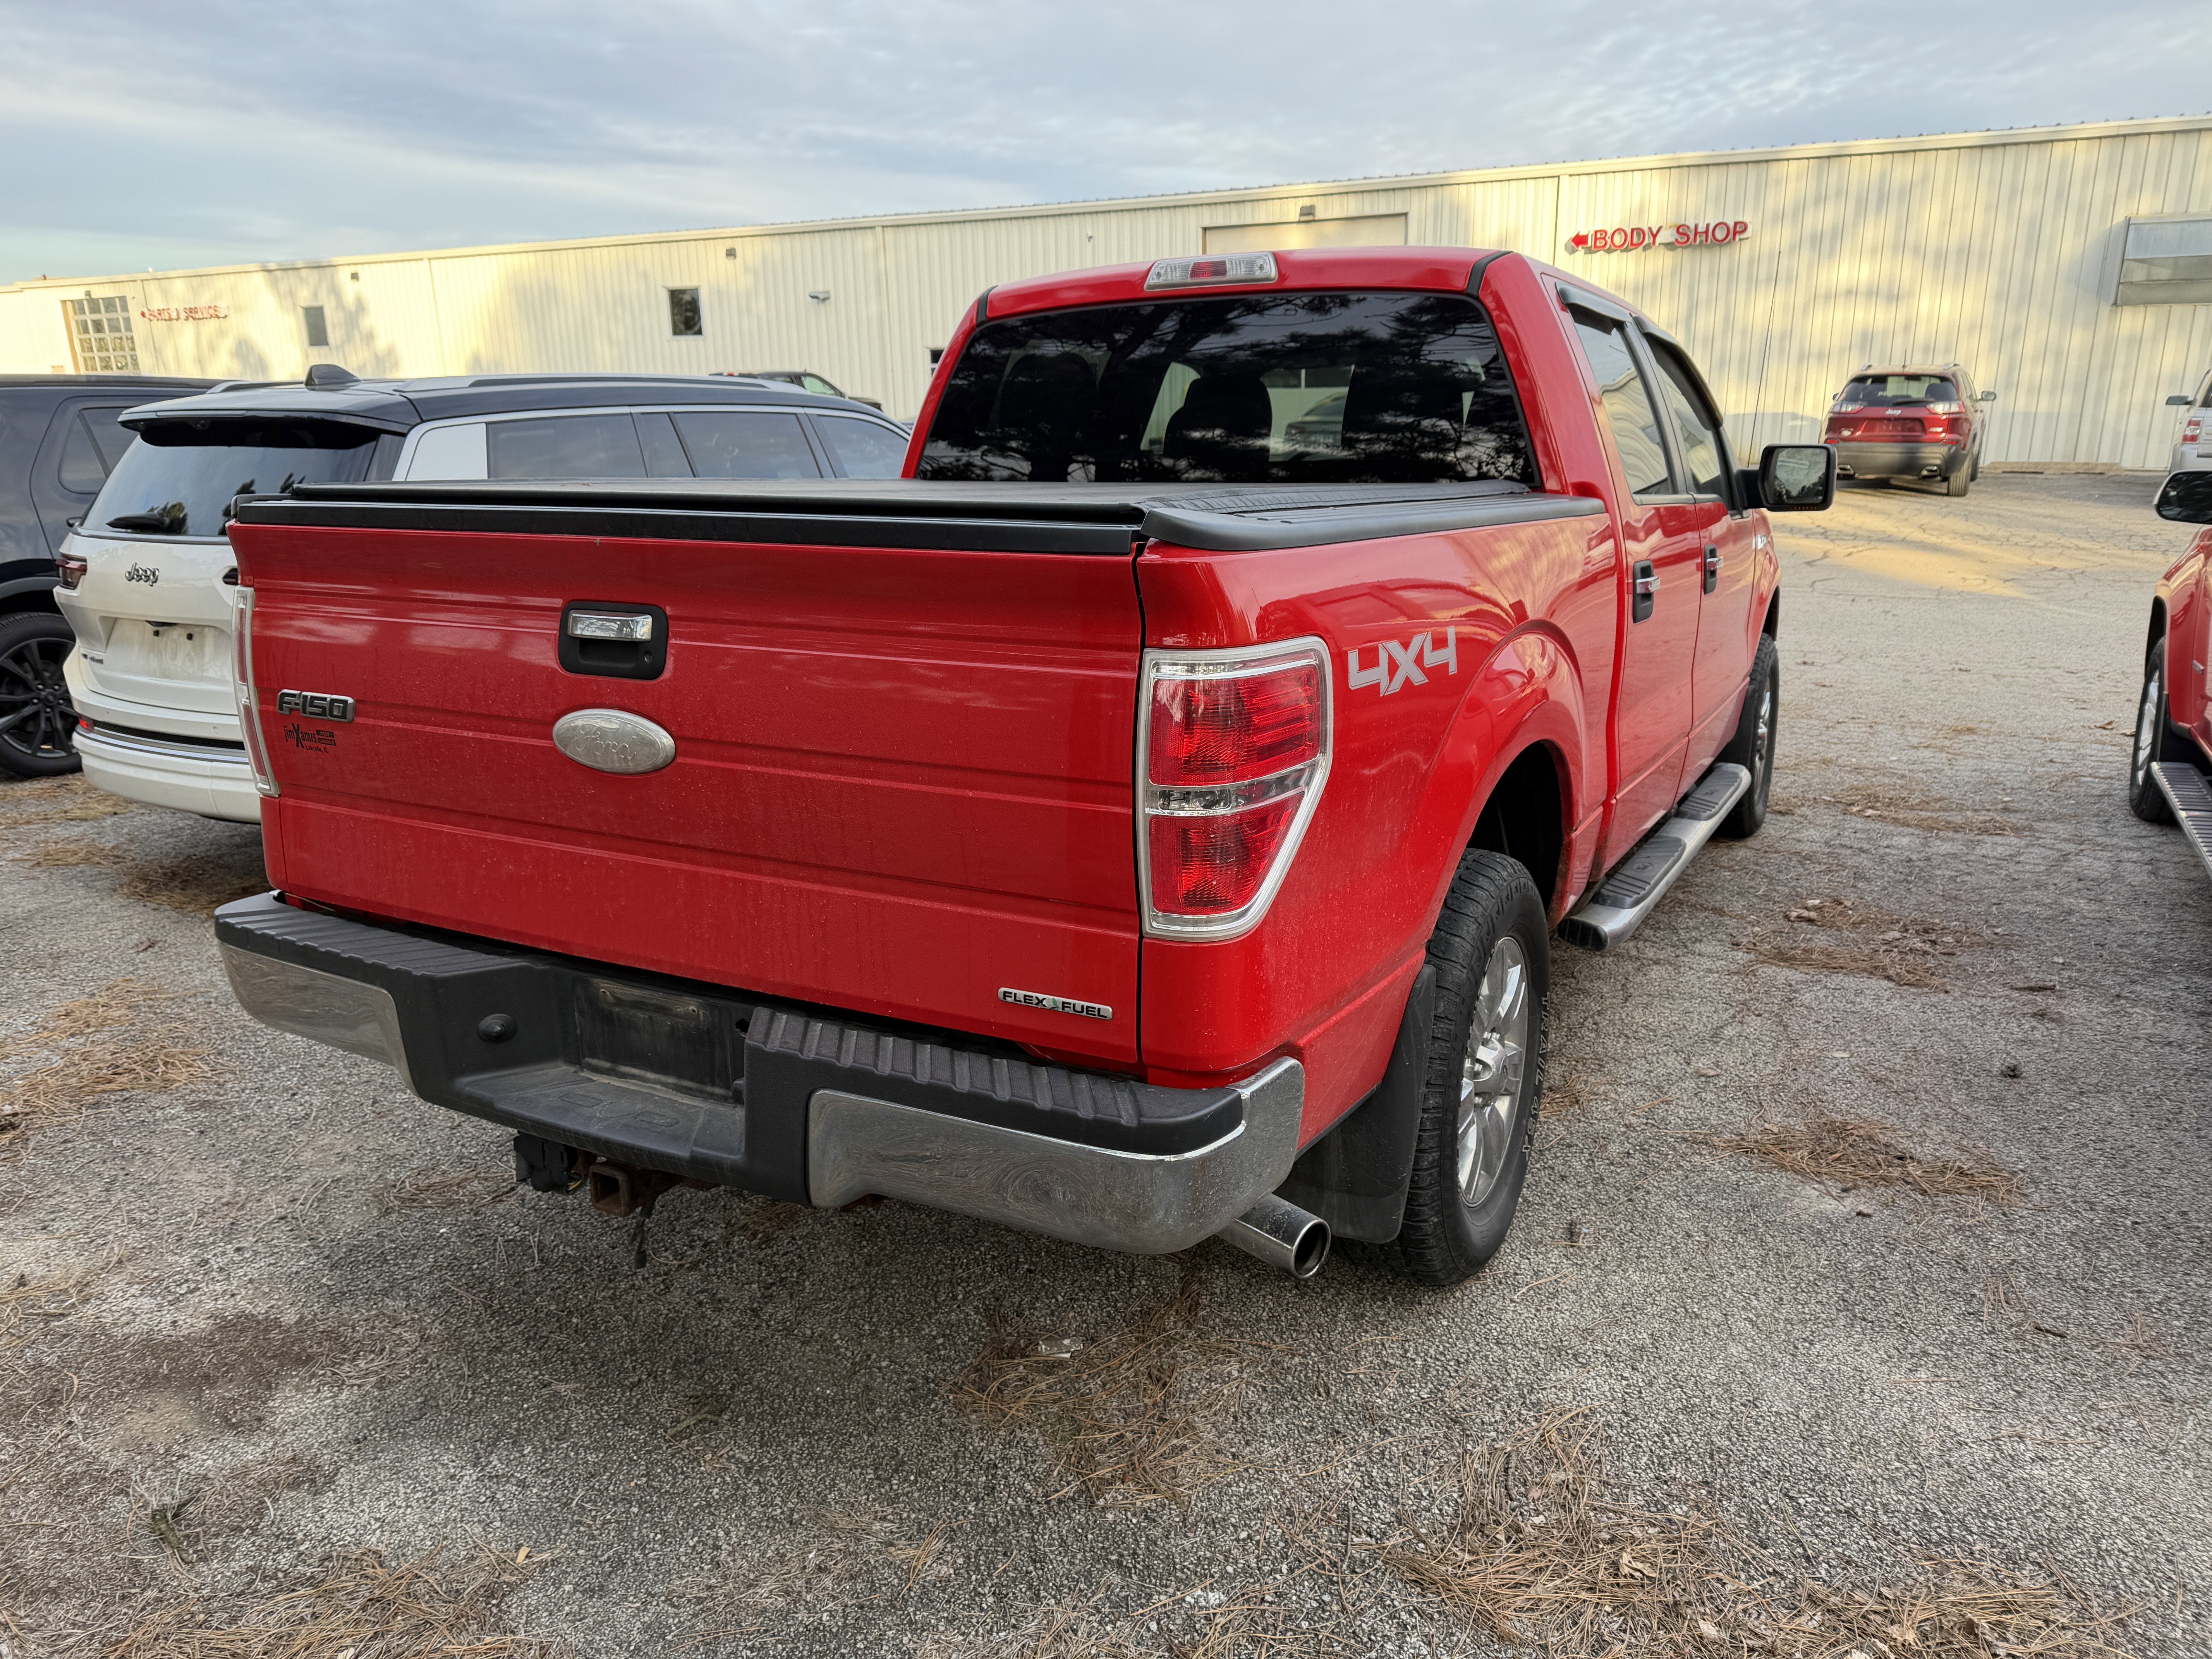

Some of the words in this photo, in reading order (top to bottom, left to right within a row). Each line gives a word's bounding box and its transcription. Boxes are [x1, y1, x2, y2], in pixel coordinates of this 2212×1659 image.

[1592, 225, 1663, 251] BODY
[1674, 221, 1749, 246] SHOP
[183, 305, 220, 321] SERVICE
[125, 562, 160, 587] Jeep
[1003, 990, 1047, 1008] FLEX
[1061, 1001, 1107, 1018] FUEL
[1535, 992, 1550, 1085] TRAIL
